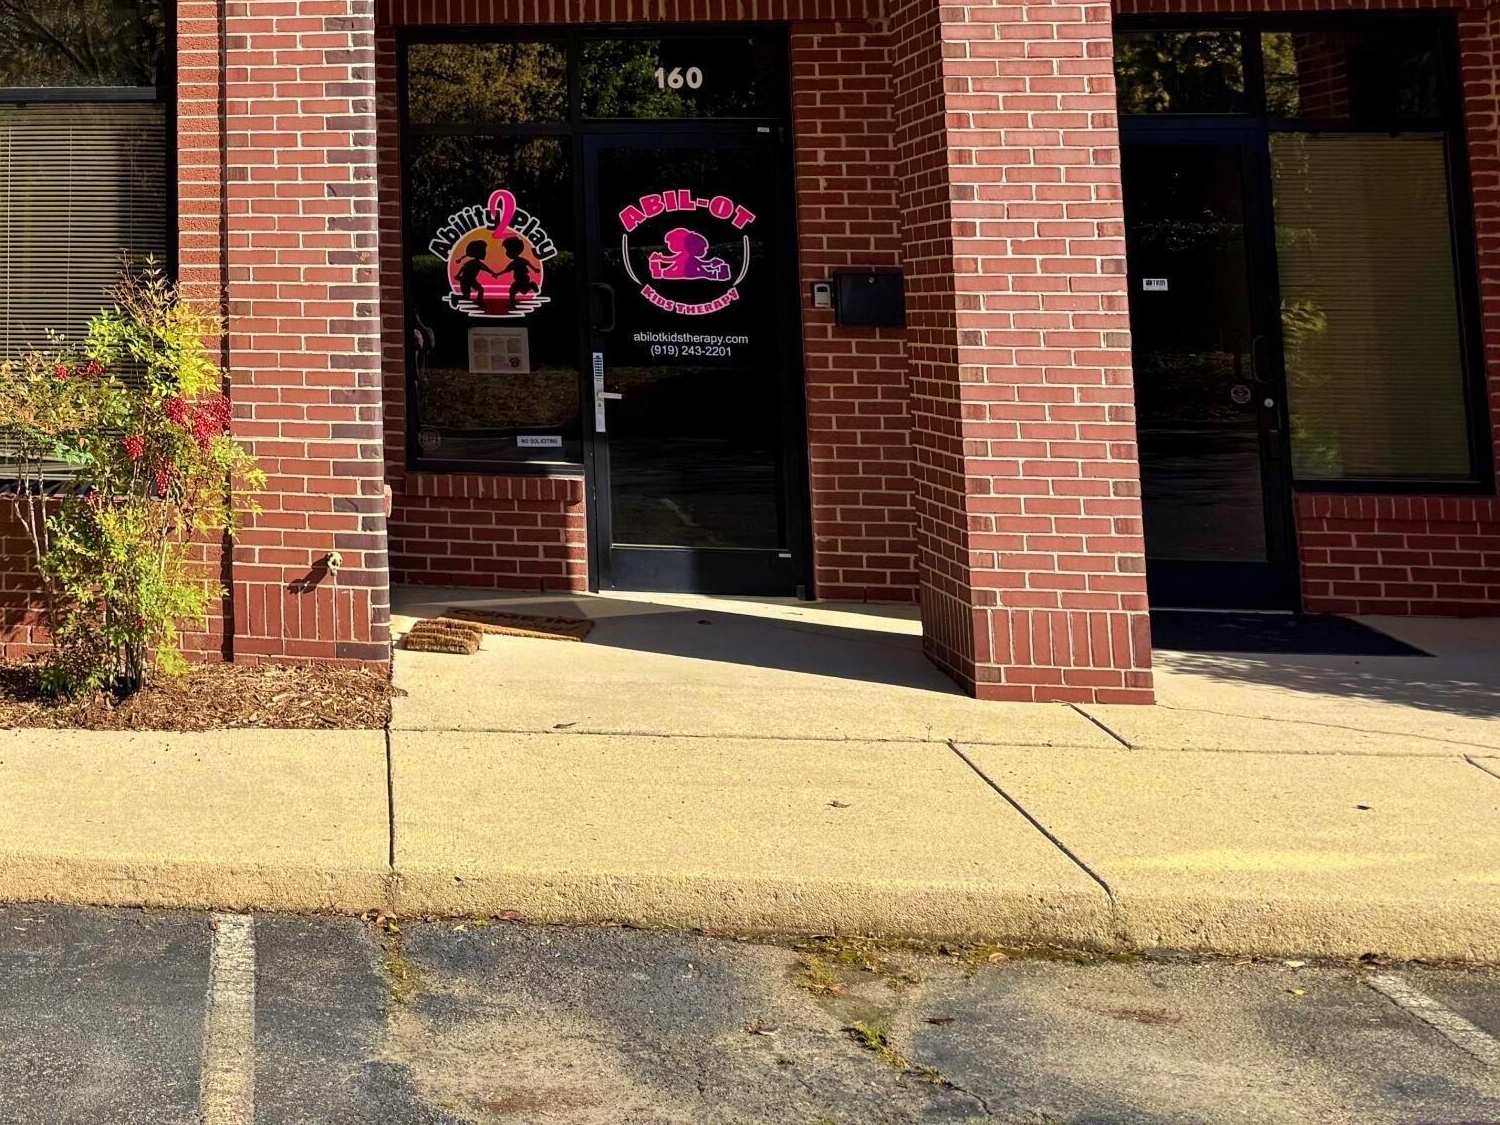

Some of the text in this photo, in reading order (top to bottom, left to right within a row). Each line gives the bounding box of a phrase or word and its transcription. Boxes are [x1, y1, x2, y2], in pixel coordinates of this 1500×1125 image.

[654, 66, 703, 90] 160
[618, 189, 756, 232] ABIL-OT
[428, 204, 501, 262] Ability
[510, 207, 558, 263] Play
[640, 284, 740, 316] KIDS THERAPY
[633, 331, 749, 346] abilotkidstherapy.com
[650, 344, 732, 357] (919) 243-2201
